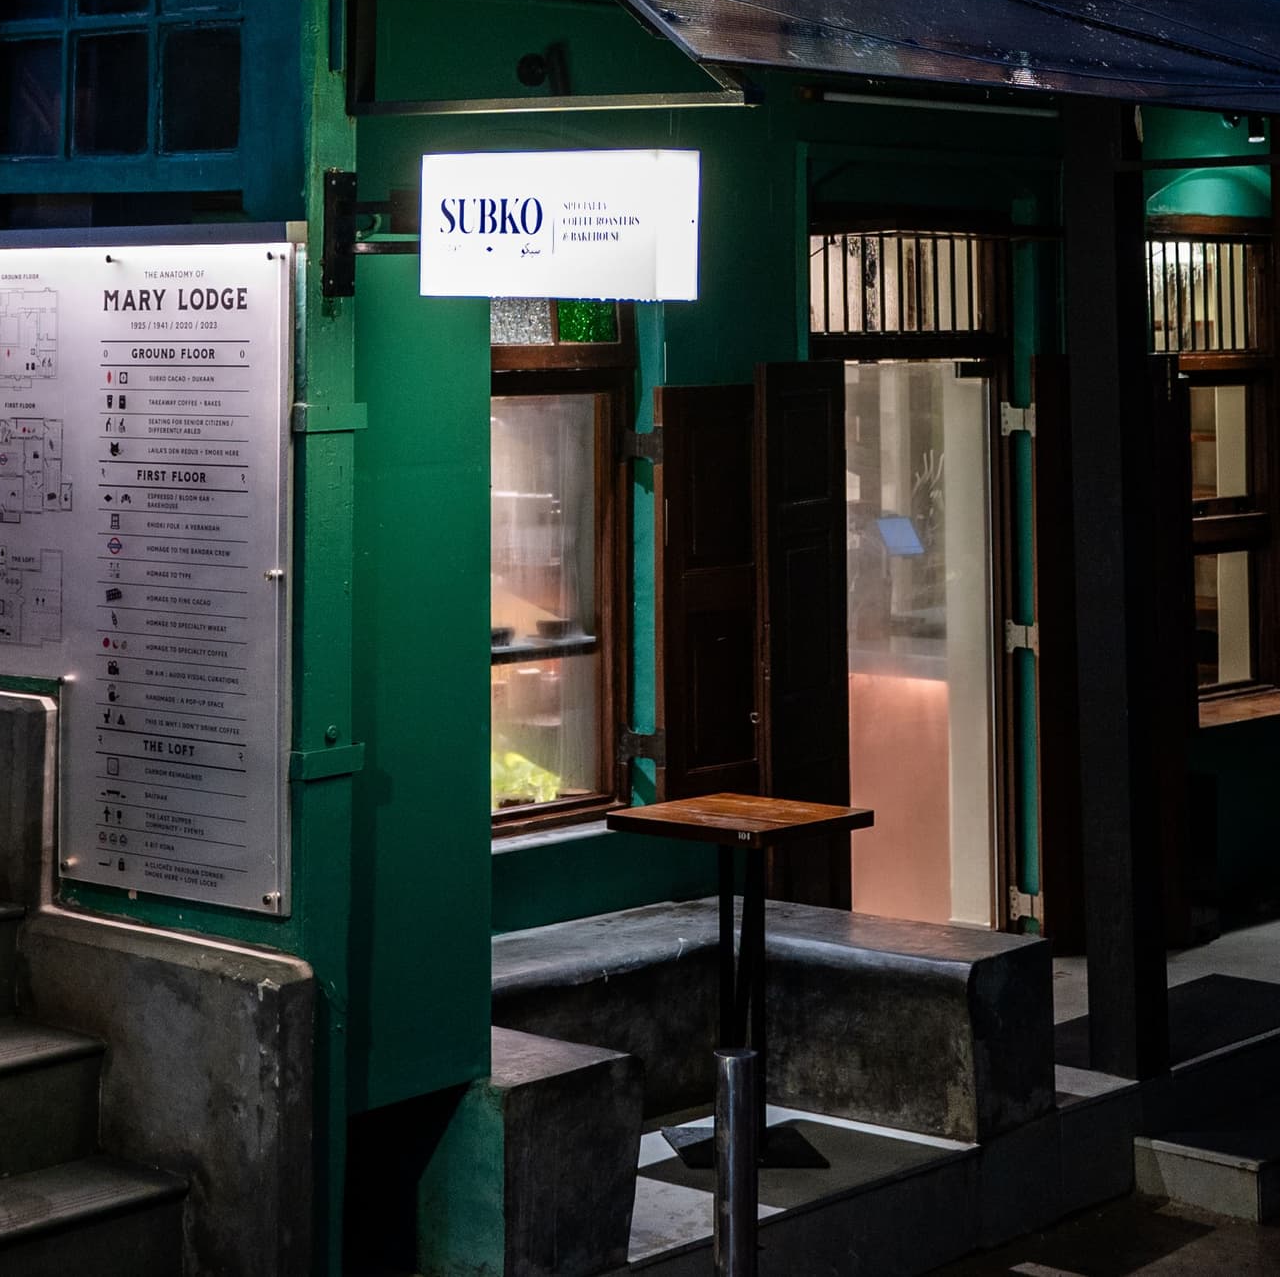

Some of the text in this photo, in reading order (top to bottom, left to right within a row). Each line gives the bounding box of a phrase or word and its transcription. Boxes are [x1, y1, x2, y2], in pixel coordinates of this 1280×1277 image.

[440, 196, 544, 236] SUBKO
[595, 216, 640, 226] ROASTERS
[570, 231, 620, 242] BAKEHOUSE
[144, 269, 205, 279] THE ANATOMY OF
[103, 286, 248, 311] MARY LODGE
[130, 321, 146, 330] 1925
[153, 321, 168, 330] 1941
[175, 321, 193, 330] 2020
[200, 321, 218, 330] 2023
[131, 348, 176, 359] GROUND
[180, 348, 216, 359] FLOOR
[204, 419, 230, 427] CITIZENS
[148, 427, 182, 435] DIFFERENTLY
[136, 469, 207, 483] FIRST FLOOR
[147, 492, 175, 500] ESPRESSO
[147, 502, 178, 510] BAKEHOUSE
[146, 570, 169, 578] HOMAGE
[178, 572, 192, 580] TYPE
[146, 595, 169, 603] HOMAGE
[146, 619, 169, 628] HOMAGE
[178, 622, 206, 631] SPECIALTY
[146, 644, 169, 653] HOMAGE
[178, 646, 206, 656] SPECIALTY
[207, 649, 228, 658] COFFEE
[168, 671, 186, 680] AUDIO
[187, 672, 207, 682] VISUAL
[207, 674, 239, 685] CURATIONS
[145, 693, 176, 704] HANDMADE
[207, 699, 225, 708] SPACE
[145, 718, 158, 726] THIS
[165, 720, 178, 728] WHY
[200, 724, 217, 733] DRINK
[218, 726, 240, 735] COFFEE
[143, 740, 195, 757] THE LOFT
[146, 812, 157, 820] THE
[157, 813, 170, 821] LAST
[145, 821, 178, 832] COMMUNITY
[183, 827, 204, 836] EVENTS
[163, 873, 178, 882] HERE
[184, 876, 198, 885] LOVE
[199, 879, 218, 888] LOCKS
